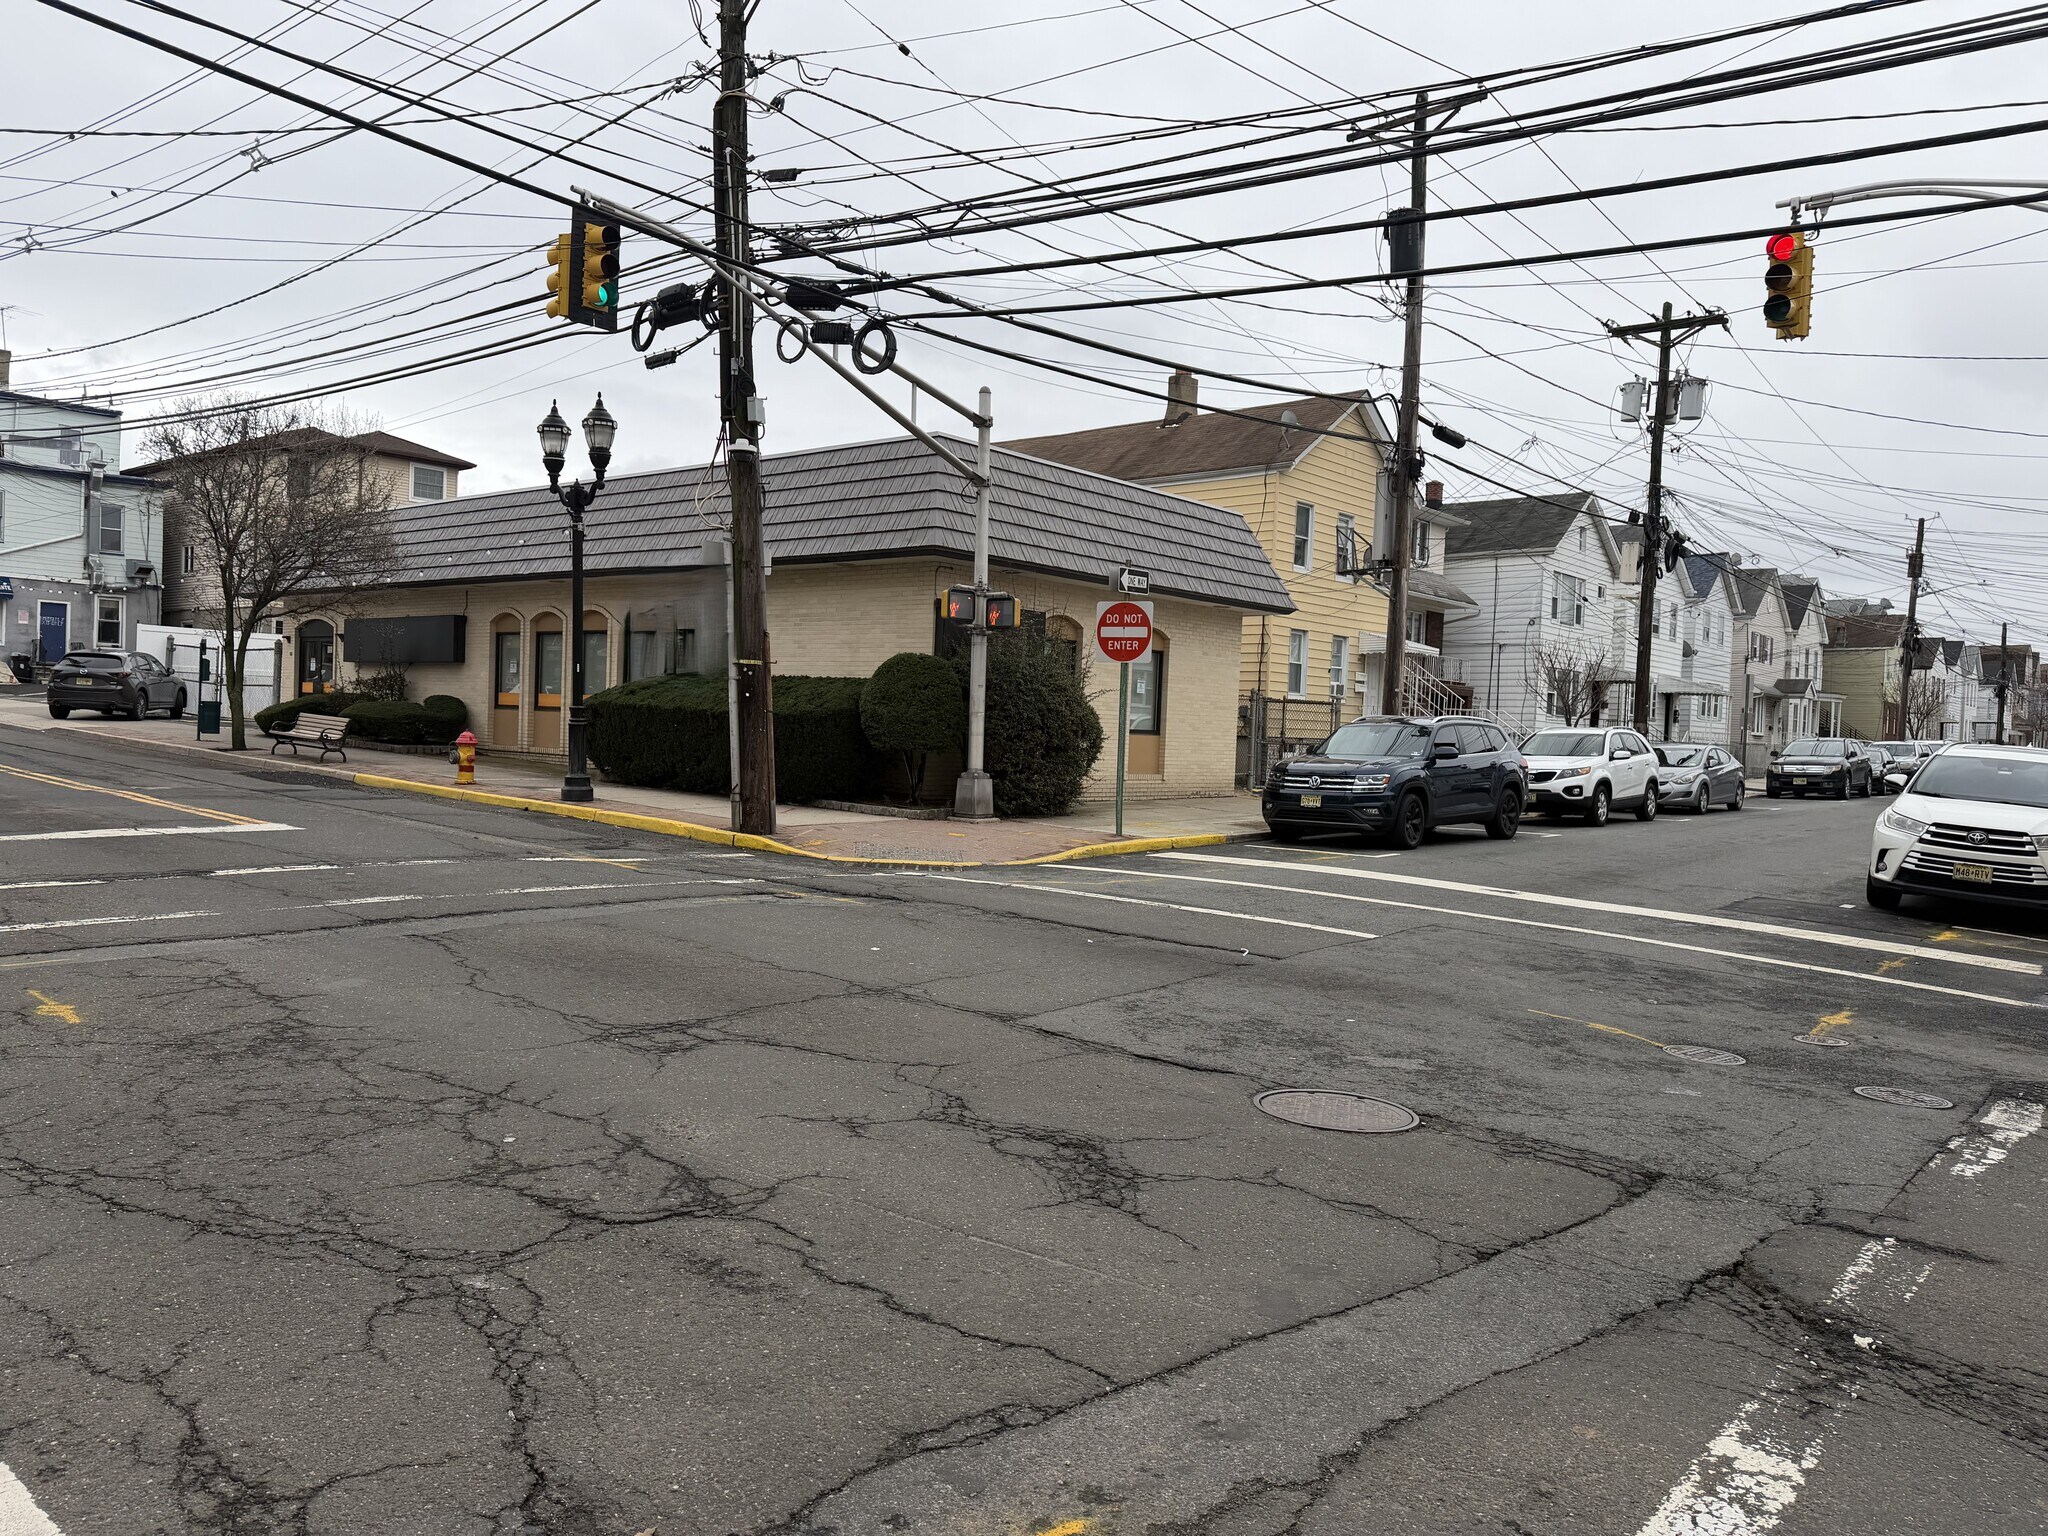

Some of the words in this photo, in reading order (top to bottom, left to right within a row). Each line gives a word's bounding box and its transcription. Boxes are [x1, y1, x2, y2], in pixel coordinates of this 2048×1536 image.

[1128, 576, 1136, 586] ONE
[1138, 577, 1146, 587] WAY
[1106, 614, 1119, 624] DO
[1124, 614, 1142, 624] NOT
[1108, 640, 1139, 650] ENTER
